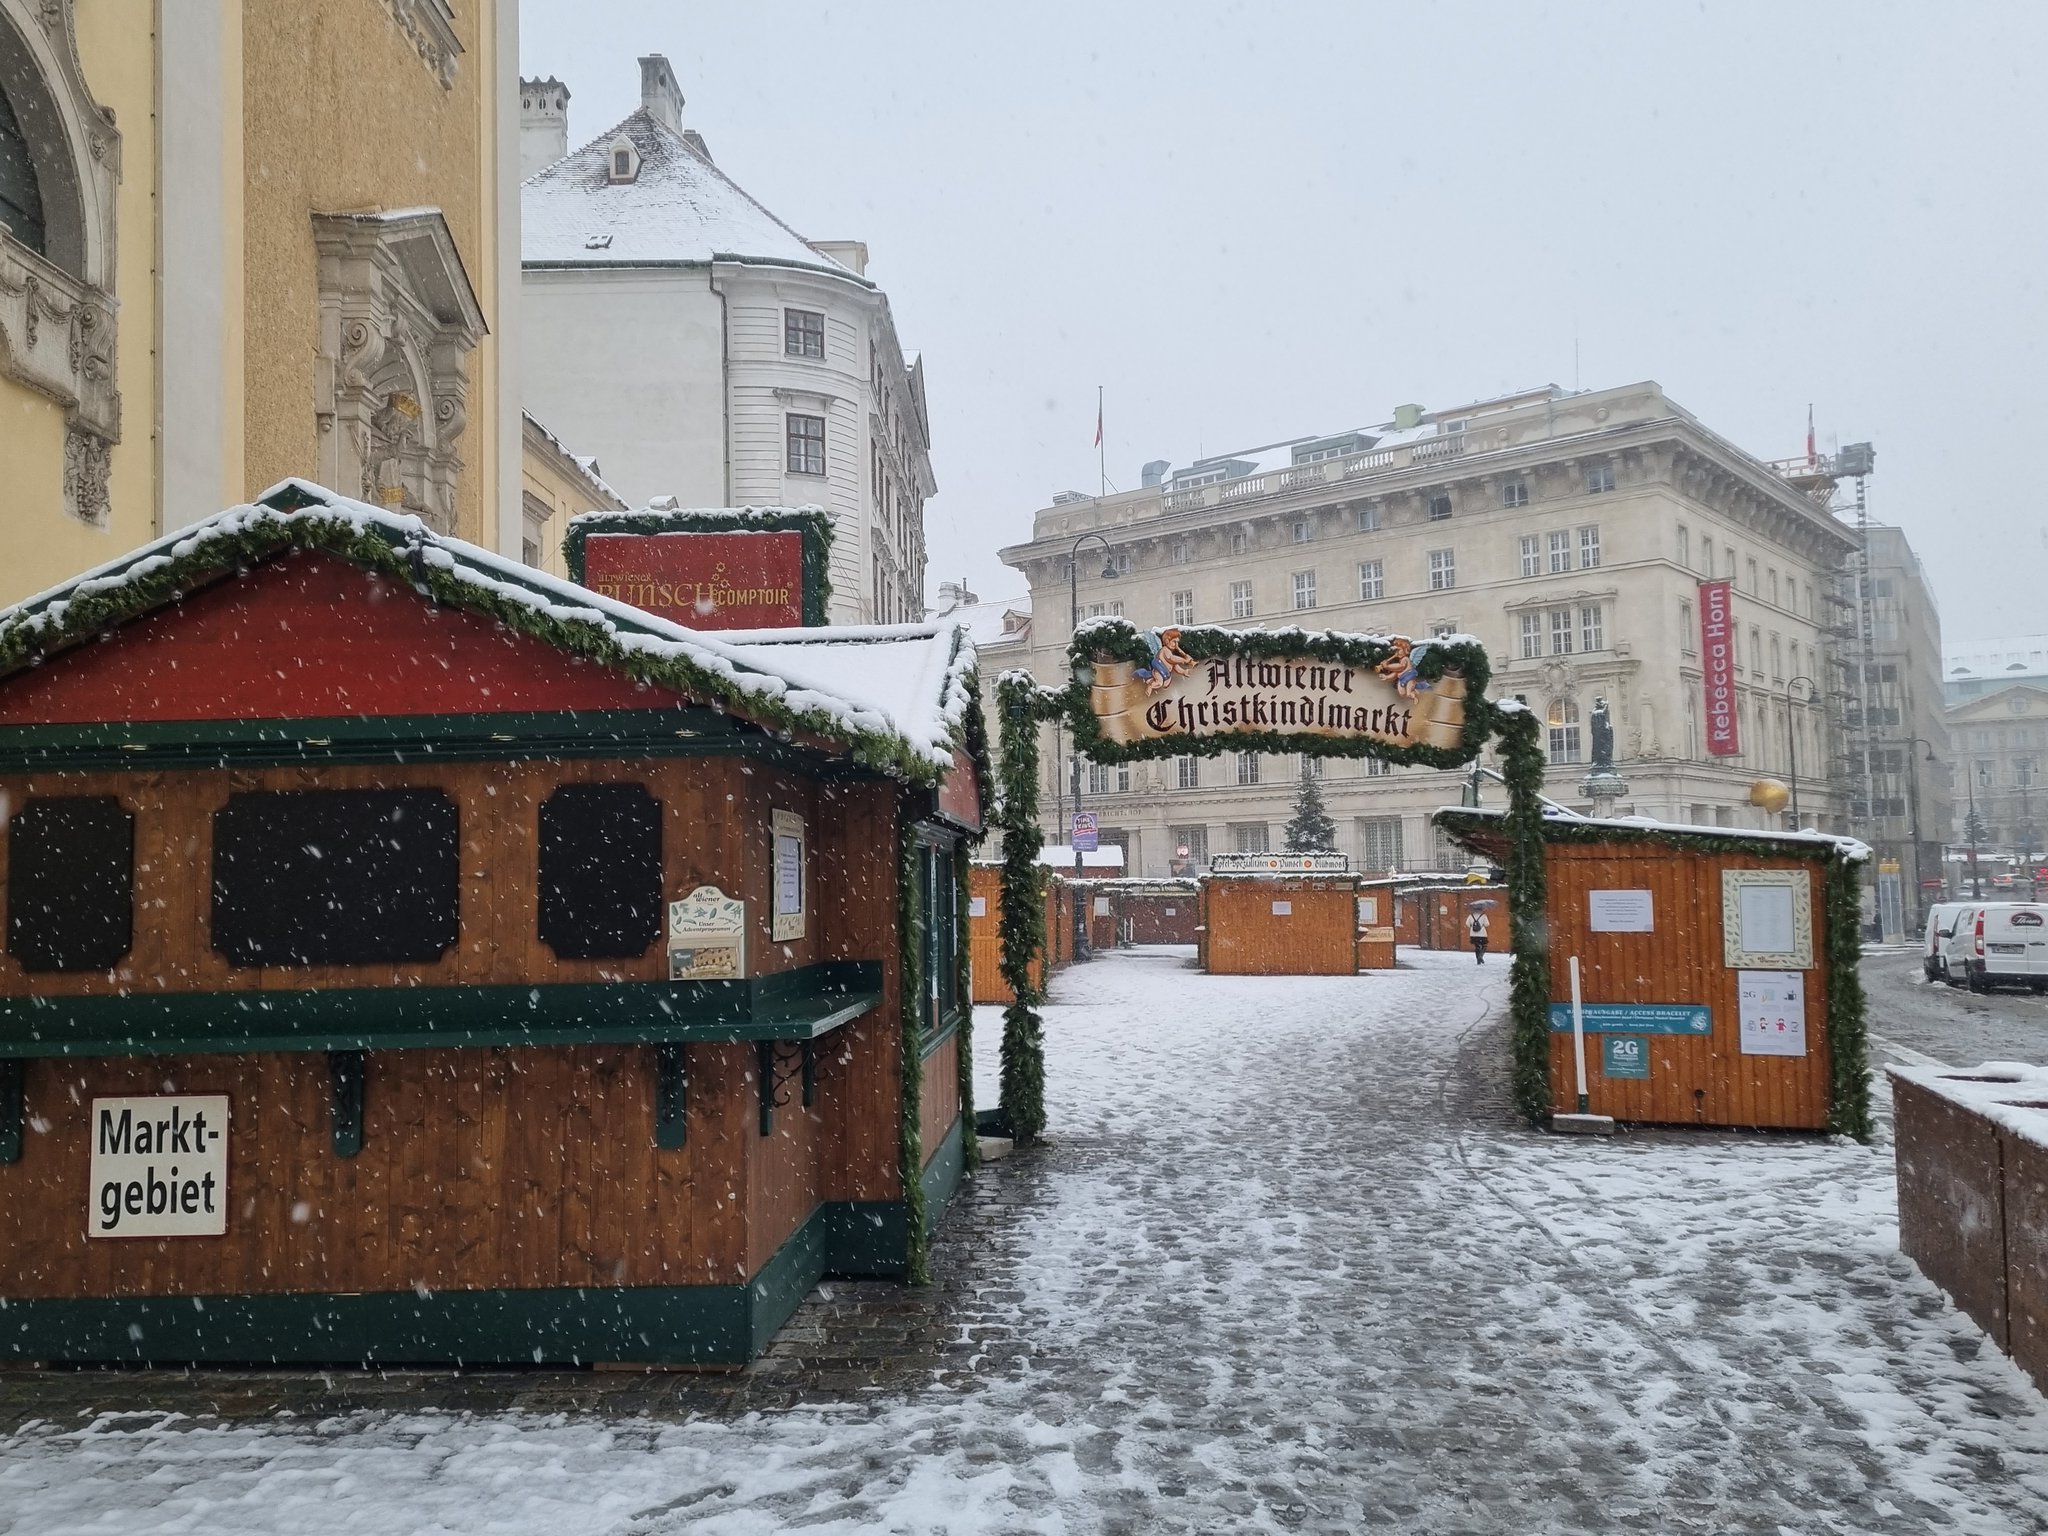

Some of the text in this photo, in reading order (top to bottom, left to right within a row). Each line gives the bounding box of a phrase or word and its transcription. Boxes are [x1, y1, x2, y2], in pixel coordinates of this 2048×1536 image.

[717, 588, 789, 606] COMPTOIR
[1206, 658, 1355, 695] Altwiener
[1707, 588, 1731, 741] Rebecca Horn
[1146, 694, 1413, 738] Christkindlmarkt
[1612, 1040, 1639, 1055] 2G
[99, 1105, 219, 1155] Markt-
[101, 1166, 215, 1230] gebiet
